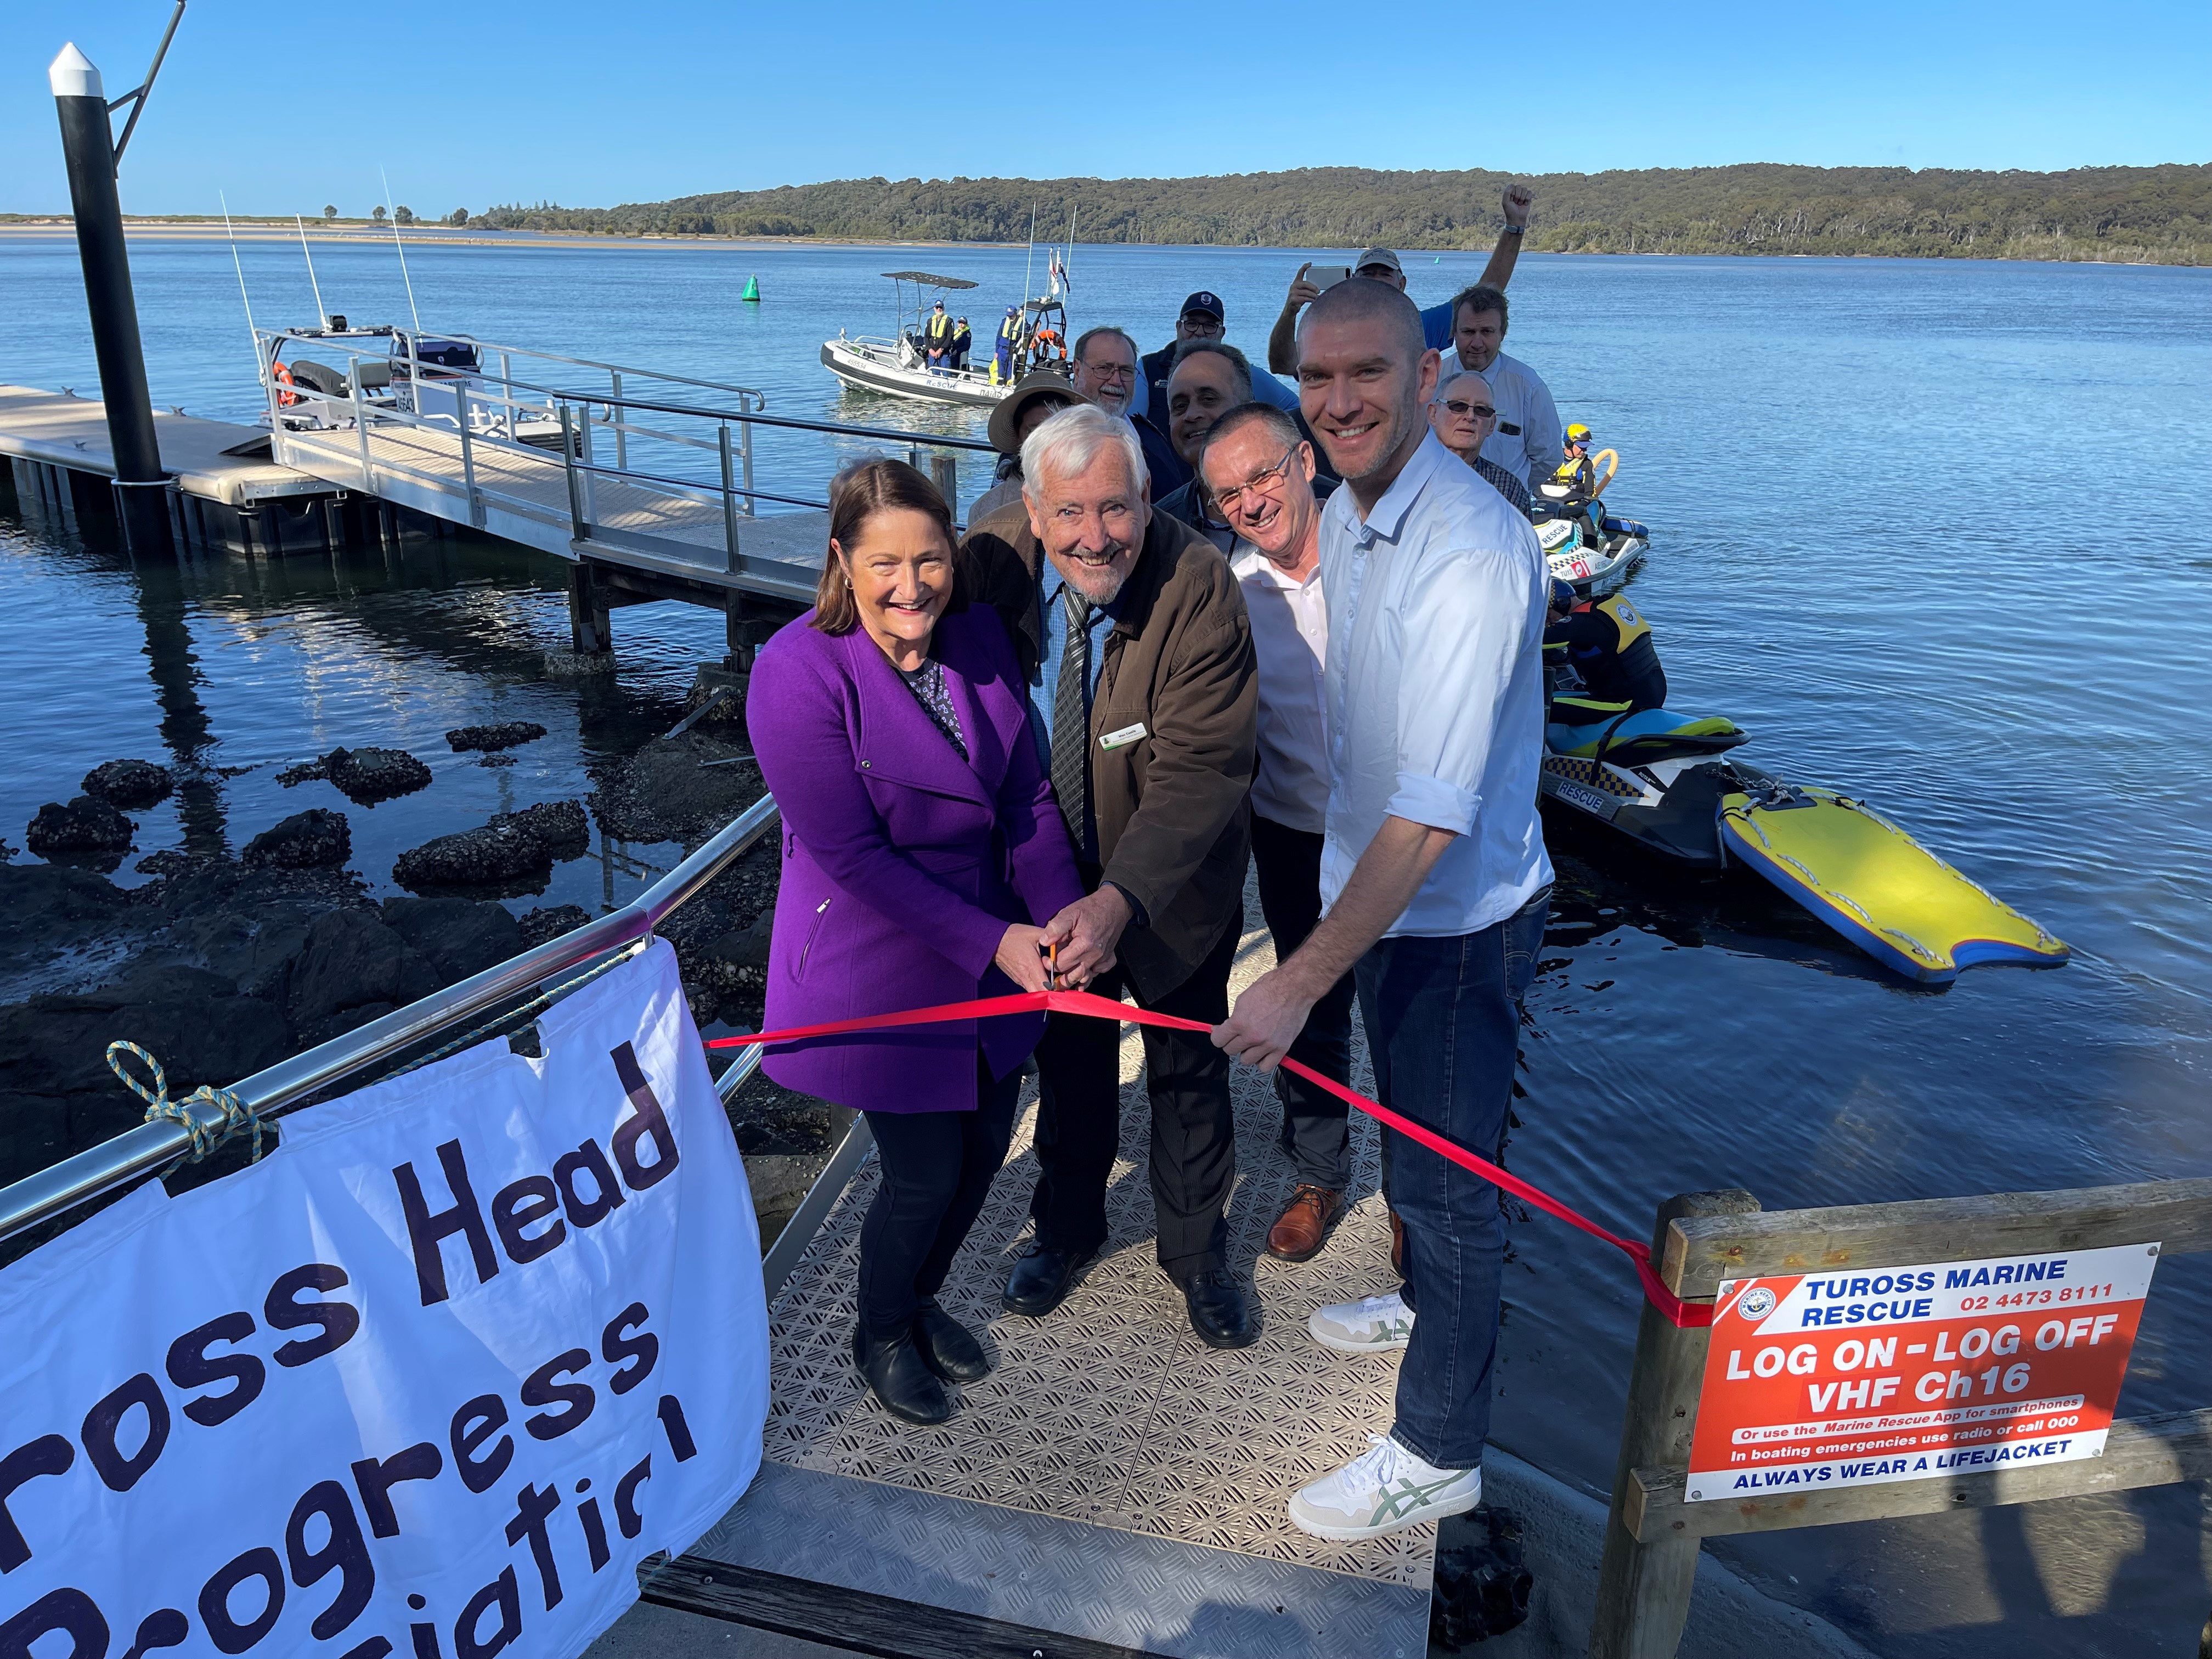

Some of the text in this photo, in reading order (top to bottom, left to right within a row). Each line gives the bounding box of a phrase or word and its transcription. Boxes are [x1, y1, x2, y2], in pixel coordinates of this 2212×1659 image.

[926, 380, 958, 390] RESCUE
[1542, 524, 1568, 544] RESCUE
[1559, 782, 1602, 810] RESCUE
[392, 1040, 679, 1306] Head
[1805, 1260, 2068, 1300] TUROSS MARINE
[1960, 1284, 2112, 1311] 02 4473 8111
[1801, 1298, 1933, 1327] RESCUE
[1726, 1344, 1818, 1380] LOG
[1833, 1337, 1898, 1370] ON
[1933, 1325, 2020, 1362] LOG
[2034, 1313, 2119, 1351] OFF
[1808, 1376, 1901, 1413] VHF
[1741, 1398, 2079, 1440] Or use the Marine Rescue App for smartphones
[1731, 1415, 2079, 1462] In boating emergencies use radio or call 000
[1733, 1440, 2072, 1489] ALWAYS WEAR A LIFEJACKET
